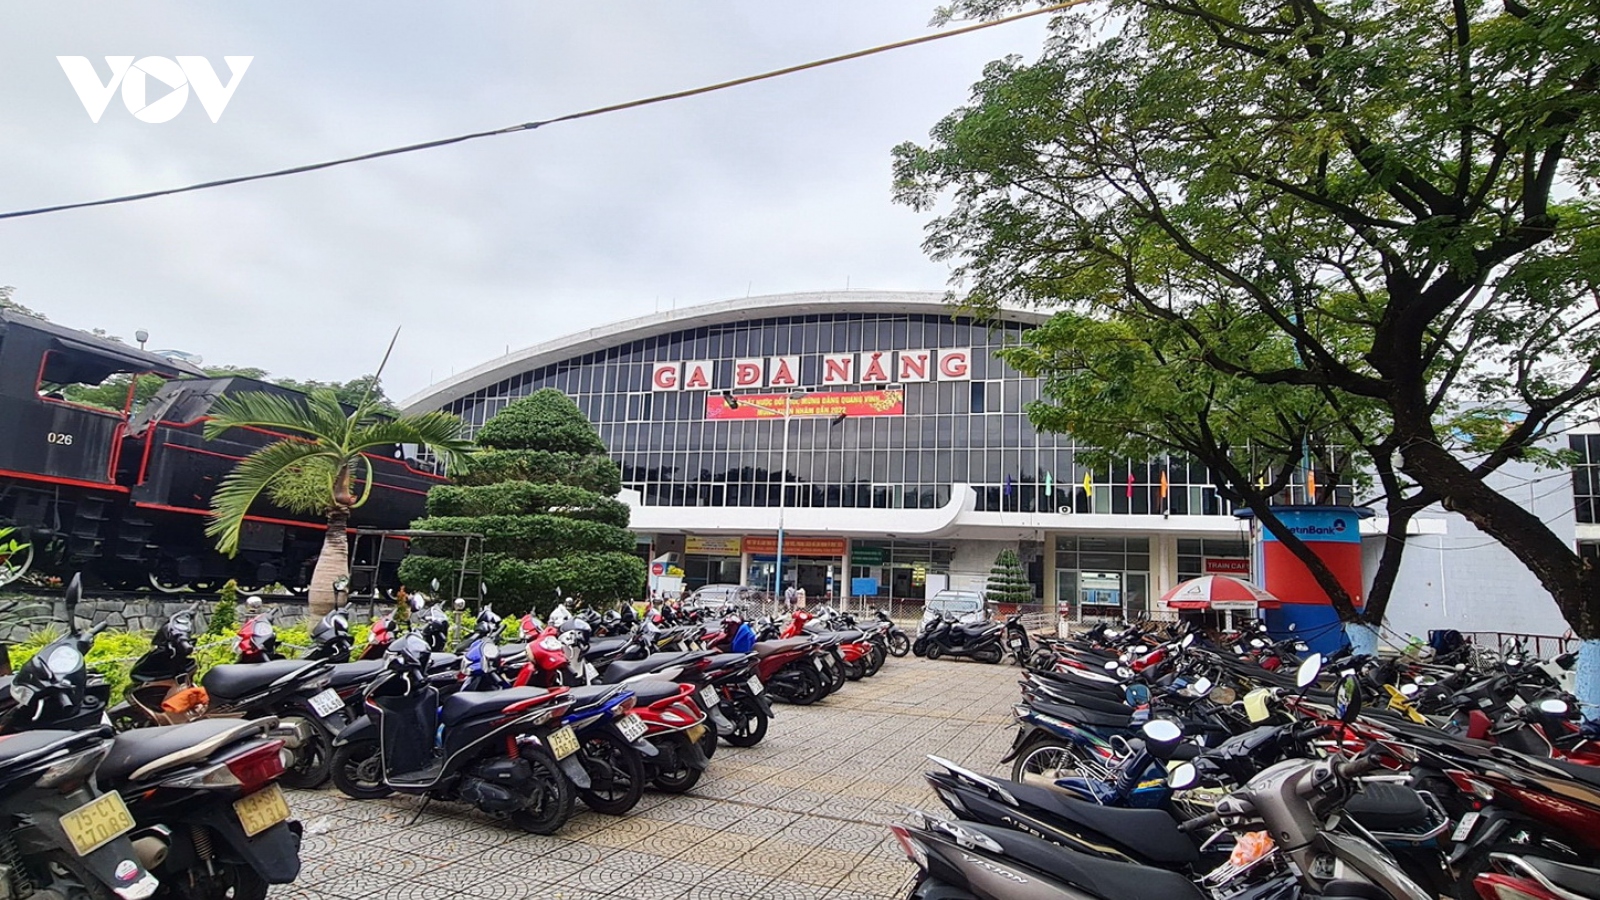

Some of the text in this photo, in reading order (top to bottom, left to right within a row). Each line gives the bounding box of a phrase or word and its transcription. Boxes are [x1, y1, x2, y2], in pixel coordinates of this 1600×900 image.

[654, 366, 709, 388] GA
[737, 358, 795, 385] ĐÀ
[47, 432, 73, 445] 026
[961, 852, 1028, 883] VISION
